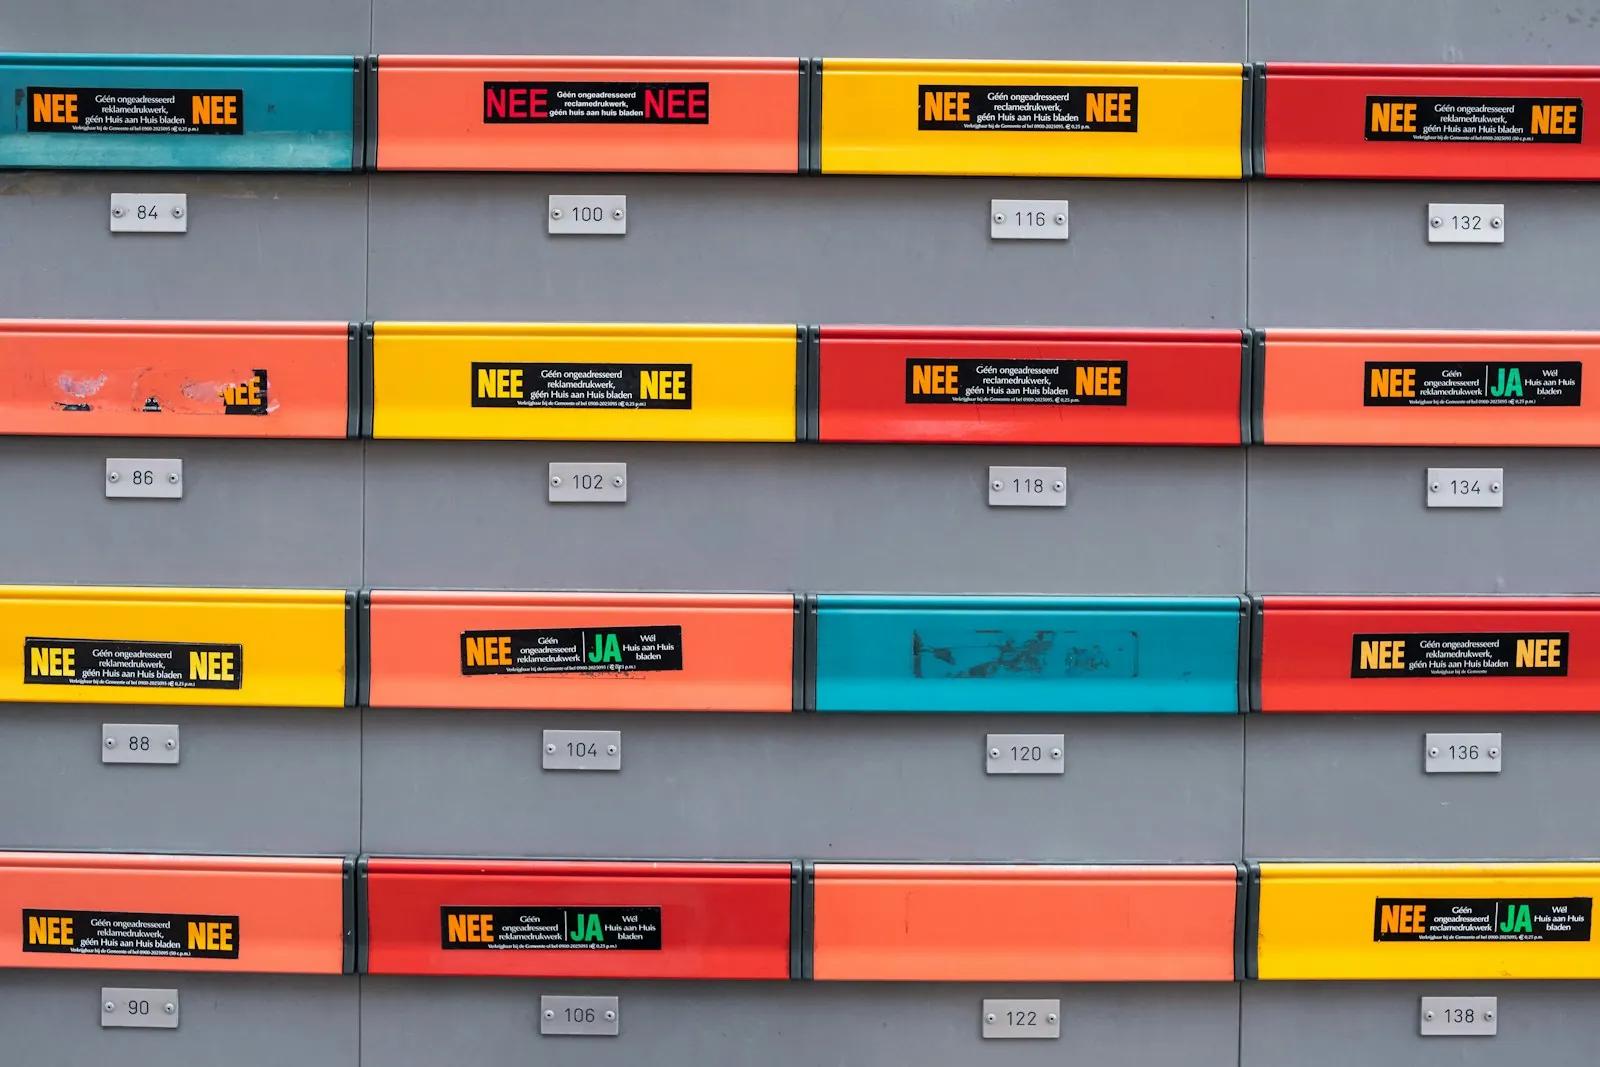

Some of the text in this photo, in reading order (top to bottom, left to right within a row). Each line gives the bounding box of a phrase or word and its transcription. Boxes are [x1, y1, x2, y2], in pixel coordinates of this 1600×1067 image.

[95, 94, 175, 105] Géén ongeadresseerd
[578, 91, 636, 100] ongeadresseerd
[987, 92, 1069, 103] Géén ongeadresseerd
[33, 94, 78, 123] NEE
[192, 95, 237, 125] NEE
[487, 89, 548, 118] NEE
[645, 90, 706, 118] NEE
[924, 92, 970, 121] NEE
[1086, 93, 1131, 122] NEE
[1434, 104, 1514, 114] Géén ongeadresseerd
[85, 115, 103, 124] géén
[140, 116, 158, 124] Huis
[159, 116, 185, 124] bladen
[549, 109, 567, 117] géén
[976, 113, 996, 123] géén
[1033, 114, 1051, 122] Huis
[1053, 114, 1079, 122] bladen
[1371, 103, 1417, 132] NEE
[1531, 105, 1576, 134] NEE
[1423, 125, 1442, 134] géén
[1479, 125, 1496, 133] Huis
[138, 205, 157, 219] 84
[573, 207, 602, 221] 100
[1016, 212, 1045, 226] 116
[1452, 216, 1481, 230] 132
[541, 369, 622, 380] Géén ongeadresseerd
[976, 366, 1059, 376] Géén ongeadresseerd
[1542, 369, 1558, 377] Wél
[478, 369, 523, 398] NEE
[640, 371, 685, 400] NEE
[913, 365, 958, 394] NEE
[1076, 367, 1121, 396] NEE
[1371, 369, 1416, 397] NEE
[1424, 379, 1479, 388] ongeadresseerd
[1491, 368, 1523, 397] JA
[530, 390, 549, 400] géén
[606, 391, 632, 399] bladen
[965, 386, 984, 396] géén
[986, 386, 1004, 394] Huis
[1042, 387, 1068, 395] bladen
[133, 471, 153, 485] 86
[573, 475, 602, 489] 102
[1013, 479, 1043, 493] 118
[1451, 480, 1480, 494] 134
[538, 637, 558, 645] Géén
[640, 634, 656, 642] Wél
[1420, 640, 1499, 650] Géén ongeadresseerd
[92, 649, 172, 660] Géén ongeadresseerd
[466, 637, 512, 666] NEE
[520, 645, 576, 654] ongeadresseerd
[588, 633, 622, 663] JA
[623, 644, 640, 652] Huis
[1360, 640, 1405, 669] NEE
[1516, 639, 1561, 668] NEE
[31, 648, 75, 676] NEE
[189, 652, 234, 681] NEE
[1409, 660, 1427, 670] géén
[1429, 660, 1446, 668] Huis
[1464, 660, 1481, 668] Huis
[1483, 660, 1509, 668] bladen
[82, 669, 101, 678] géén
[156, 671, 182, 679] bladen
[130, 736, 149, 750] 88
[568, 743, 597, 757] 104
[1012, 747, 1041, 761] 120
[1449, 745, 1478, 760] 136
[1452, 906, 1472, 914] Géén
[1552, 906, 1567, 914] Wél
[90, 919, 171, 930] Géén ongeadresseerd
[520, 915, 540, 923] Géén
[621, 915, 638, 923] Wél
[1380, 905, 1426, 933] NEE
[1433, 915, 1489, 924] ongeadresseerd
[1500, 905, 1532, 932] JA
[29, 916, 73, 945] NEE
[448, 914, 494, 942] NEE
[502, 924, 559, 933] ongeadresseerd
[570, 914, 604, 942] JA
[605, 924, 621, 932] Huis
[188, 922, 232, 950] NEE
[80, 938, 99, 948] géén
[100, 939, 118, 947] Huis
[136, 940, 153, 948] Huis
[155, 940, 181, 949] bladen
[129, 1000, 148, 1014] 90
[565, 1008, 594, 1022] 106
[1007, 1012, 1036, 1026] 122
[1445, 1009, 1474, 1023] 138
